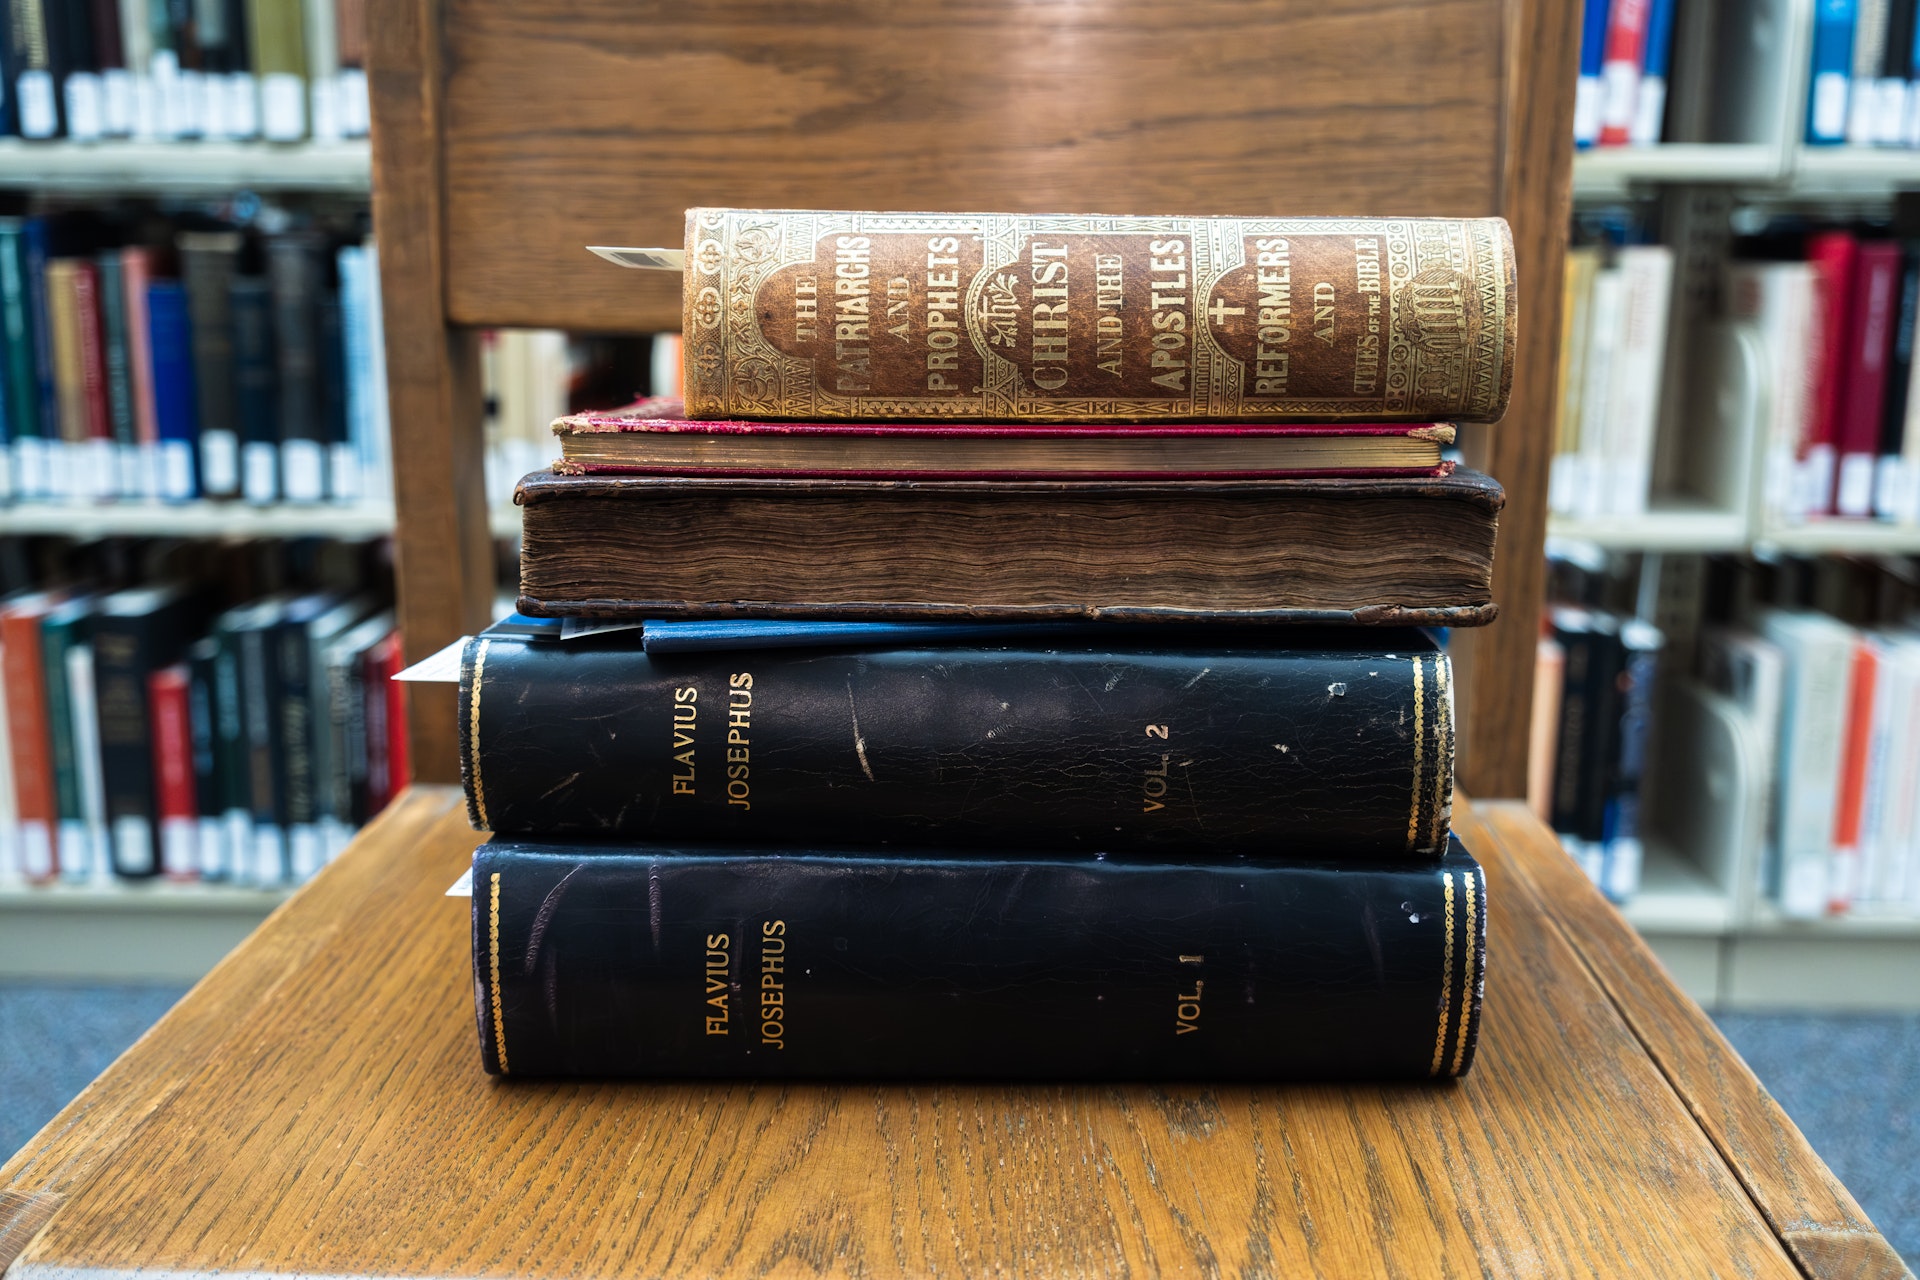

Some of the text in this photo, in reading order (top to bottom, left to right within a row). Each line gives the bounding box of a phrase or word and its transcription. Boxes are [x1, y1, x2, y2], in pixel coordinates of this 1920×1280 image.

[795, 275, 818, 342] THE
[836, 236, 871, 391] PATRIARCHS
[887, 276, 911, 344] AND
[927, 236, 959, 391] PROPHETS
[1032, 242, 1069, 390] CHRIST
[1096, 254, 1123, 378] AND THE
[1149, 238, 1186, 391] APOSTLES
[1255, 238, 1291, 394] REFORMERS
[1314, 282, 1335, 347] AND
[1354, 238, 1381, 394] CITIES OF THE BIBLE
[672, 686, 698, 796] FLAVIUS
[727, 672, 754, 811] JOSEPHUS
[1143, 723, 1169, 813] VOL. 2
[705, 933, 730, 1035] FLAVIUS
[762, 919, 785, 1050] JOSEPHUS
[1176, 954, 1204, 1035] VOL. 1
